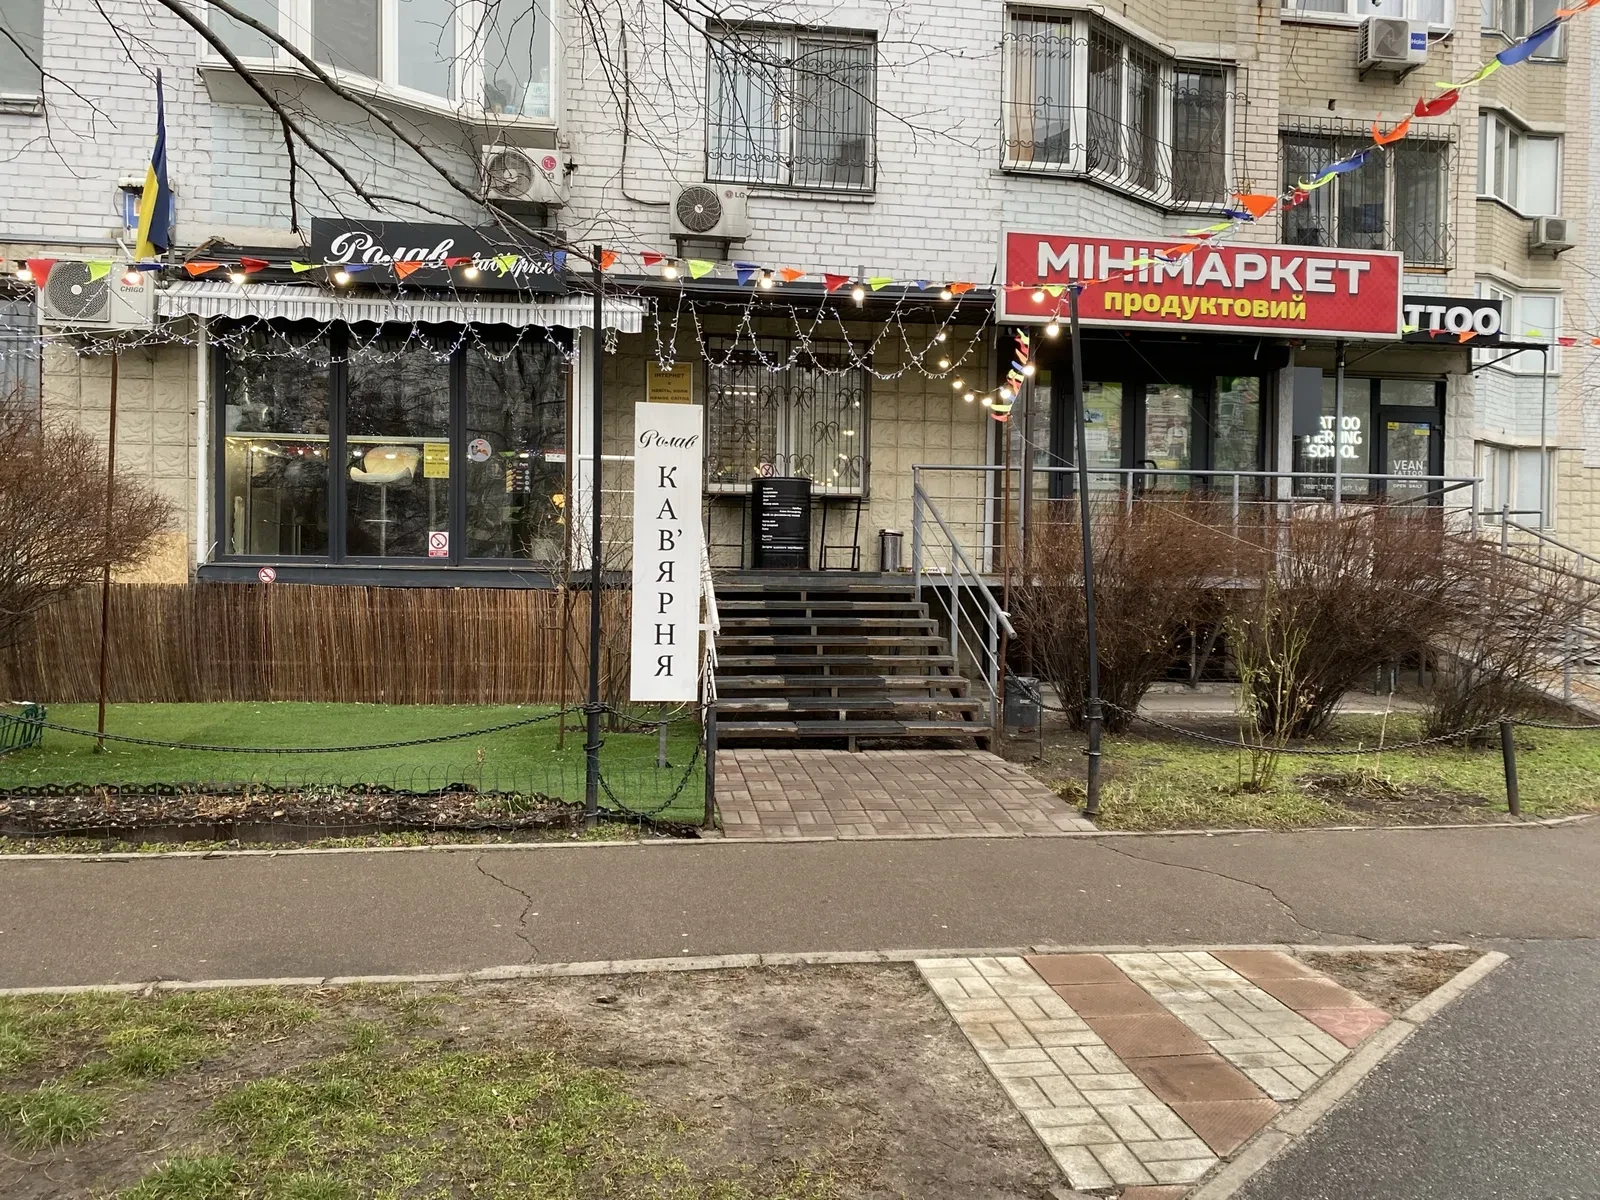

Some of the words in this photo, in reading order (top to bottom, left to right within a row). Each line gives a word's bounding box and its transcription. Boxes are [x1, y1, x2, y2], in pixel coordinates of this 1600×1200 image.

[1037, 241, 1370, 294] МІНІМАРКЕТ
[1104, 290, 1306, 320] продуктовий
[1402, 304, 1500, 335] TTOO
[638, 429, 699, 449] Ролав
[1308, 444, 1359, 458] SCHOL
[1393, 460, 1423, 470] VEAN
